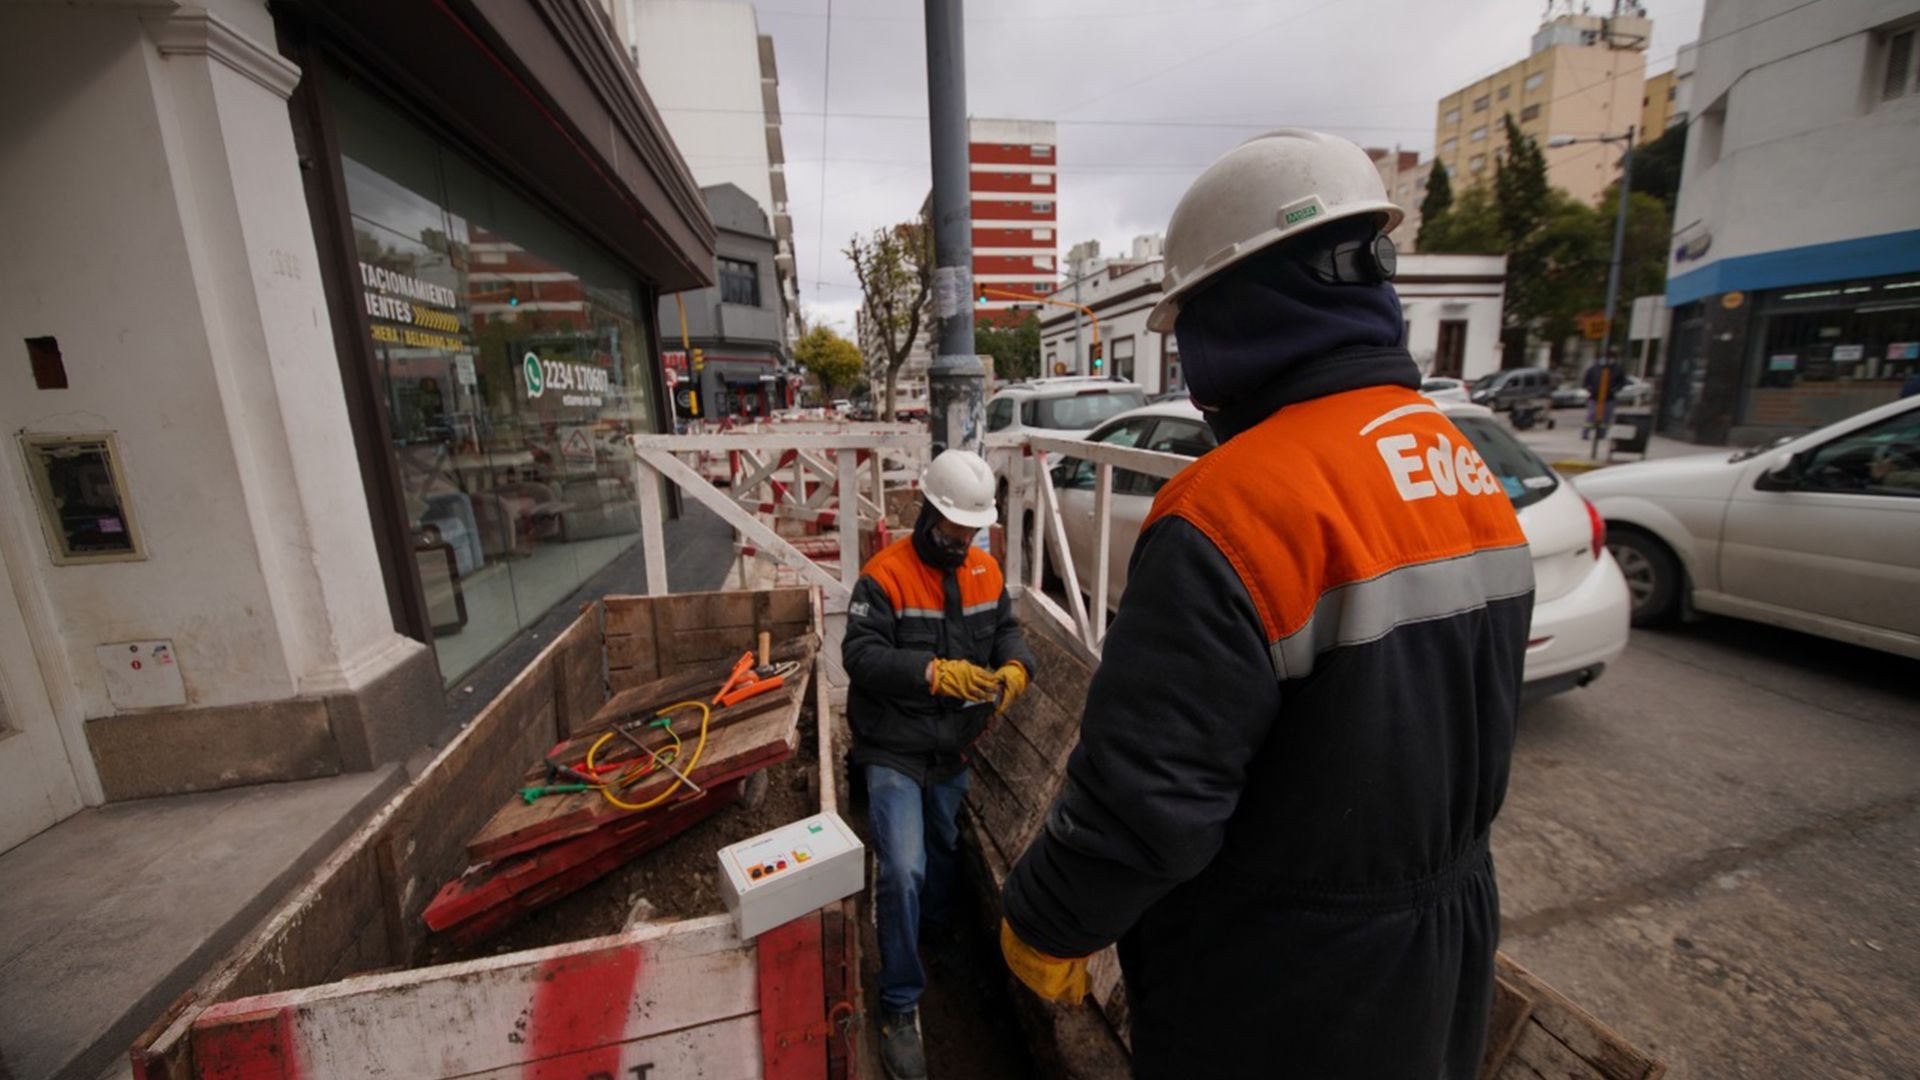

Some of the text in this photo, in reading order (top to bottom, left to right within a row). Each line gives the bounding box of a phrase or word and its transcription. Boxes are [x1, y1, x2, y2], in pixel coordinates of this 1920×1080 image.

[359, 261, 456, 309] TACIONAMIENTO
[364, 292, 412, 323] IENTES
[543, 359, 574, 390] 2234
[1376, 433, 1500, 501] Edea
